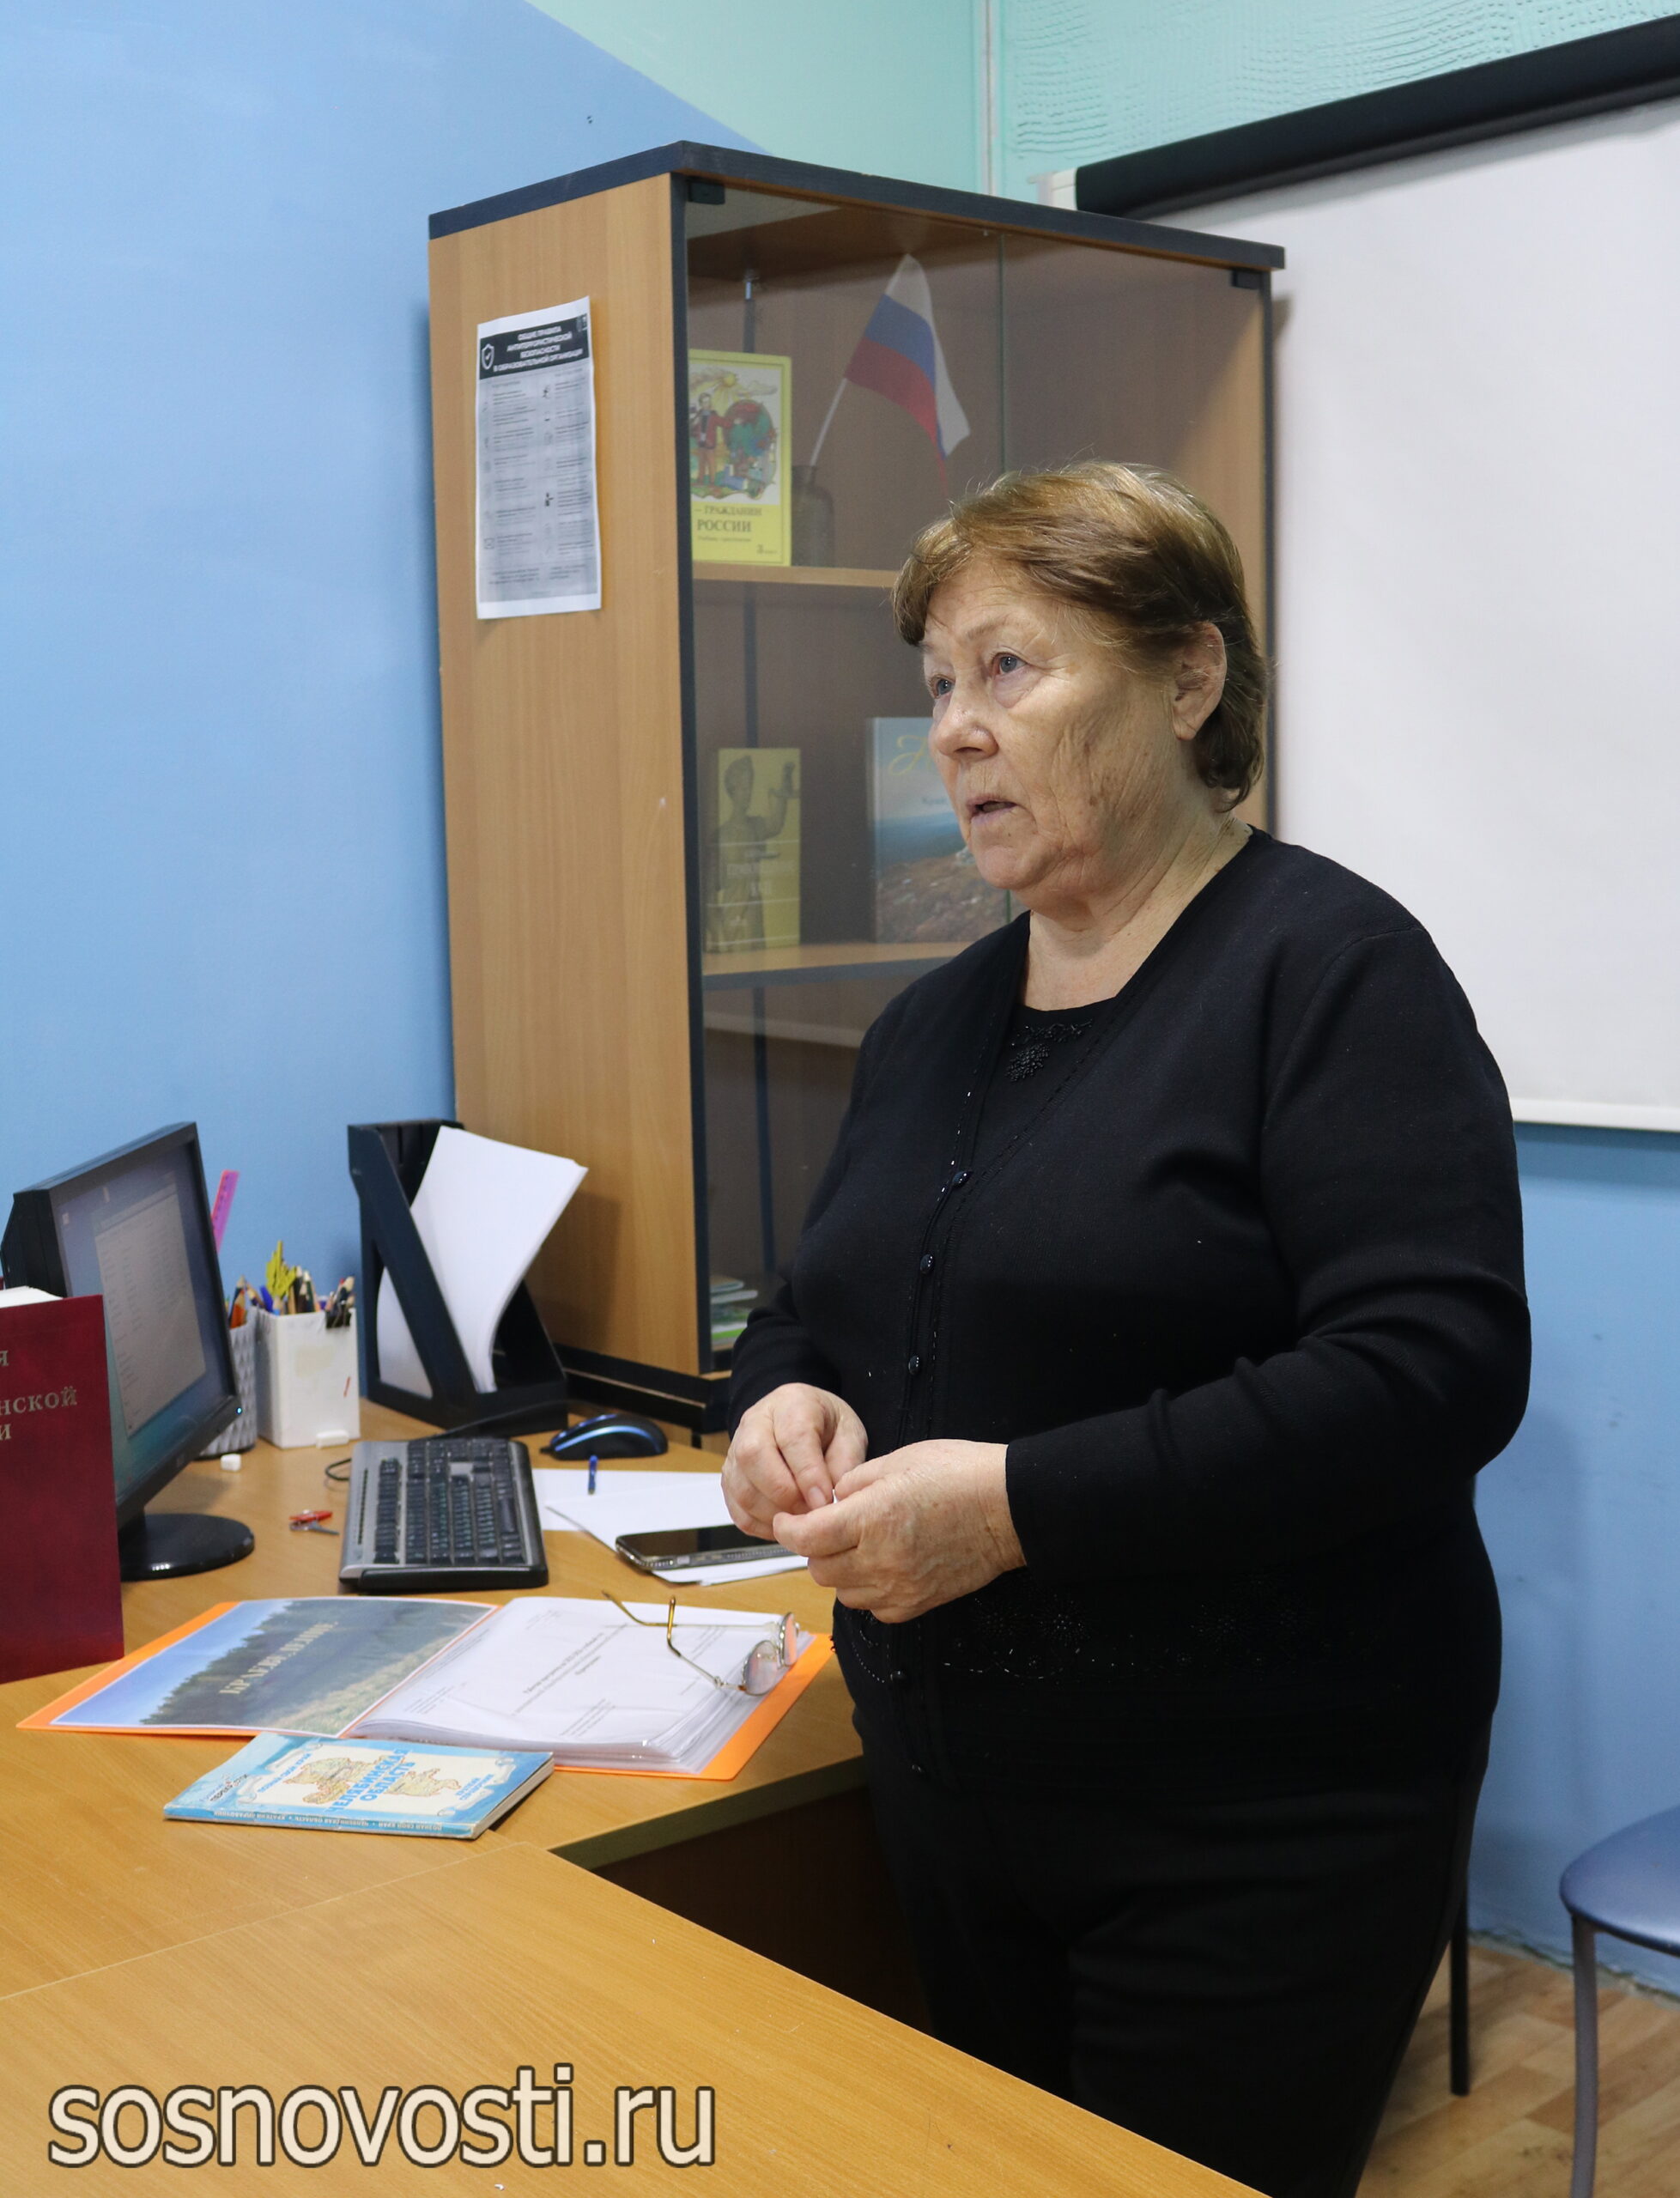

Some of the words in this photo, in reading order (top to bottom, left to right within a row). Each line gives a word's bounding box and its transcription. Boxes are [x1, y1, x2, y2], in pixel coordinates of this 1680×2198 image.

[696, 519, 752, 532] РОССИИ
[704, 505, 763, 516] ГРАЖДАНИН
[0, 1386, 77, 1416] НСКОЙ
[324, 1748, 411, 1812] ЧЕЛЯБИНСКАЯ
[359, 1760, 416, 1801] ОБЛАСТЬ
